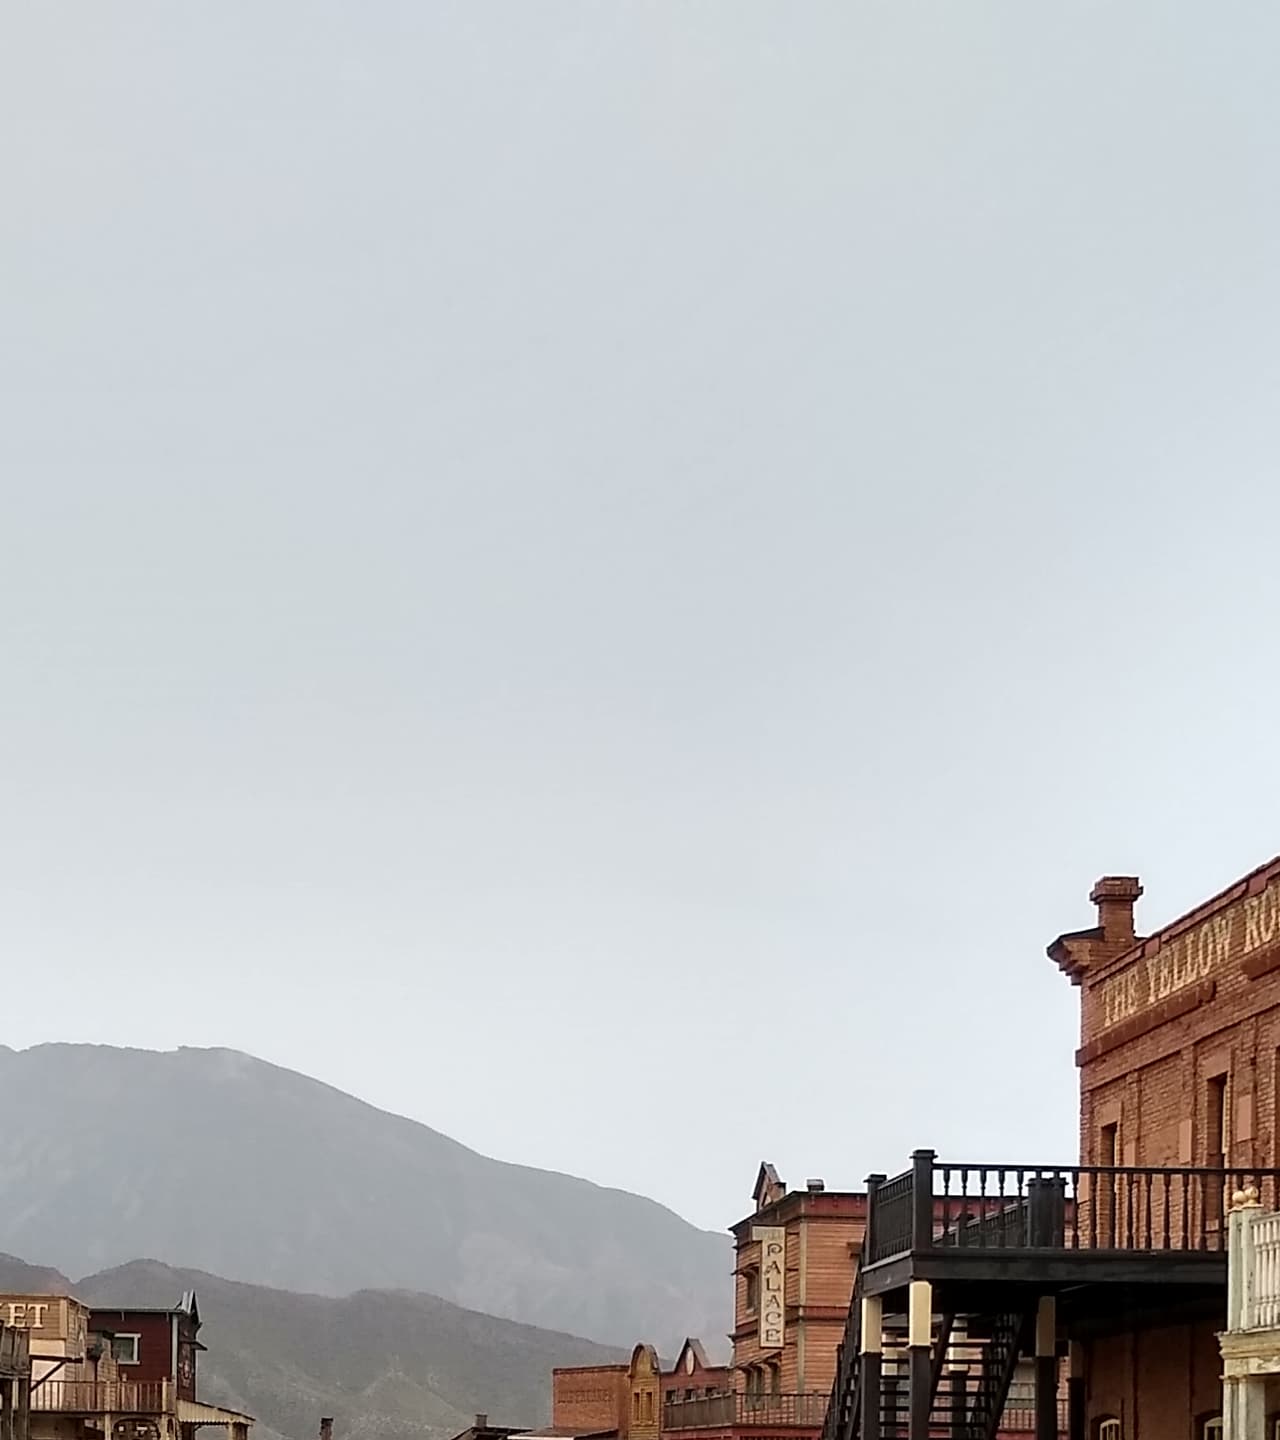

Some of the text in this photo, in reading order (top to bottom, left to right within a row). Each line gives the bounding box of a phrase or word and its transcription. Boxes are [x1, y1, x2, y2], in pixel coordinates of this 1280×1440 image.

[1102, 965, 1139, 1027] THE
[1146, 908, 1235, 1004] YELLOW
[764, 1242, 783, 1343] PALACE
